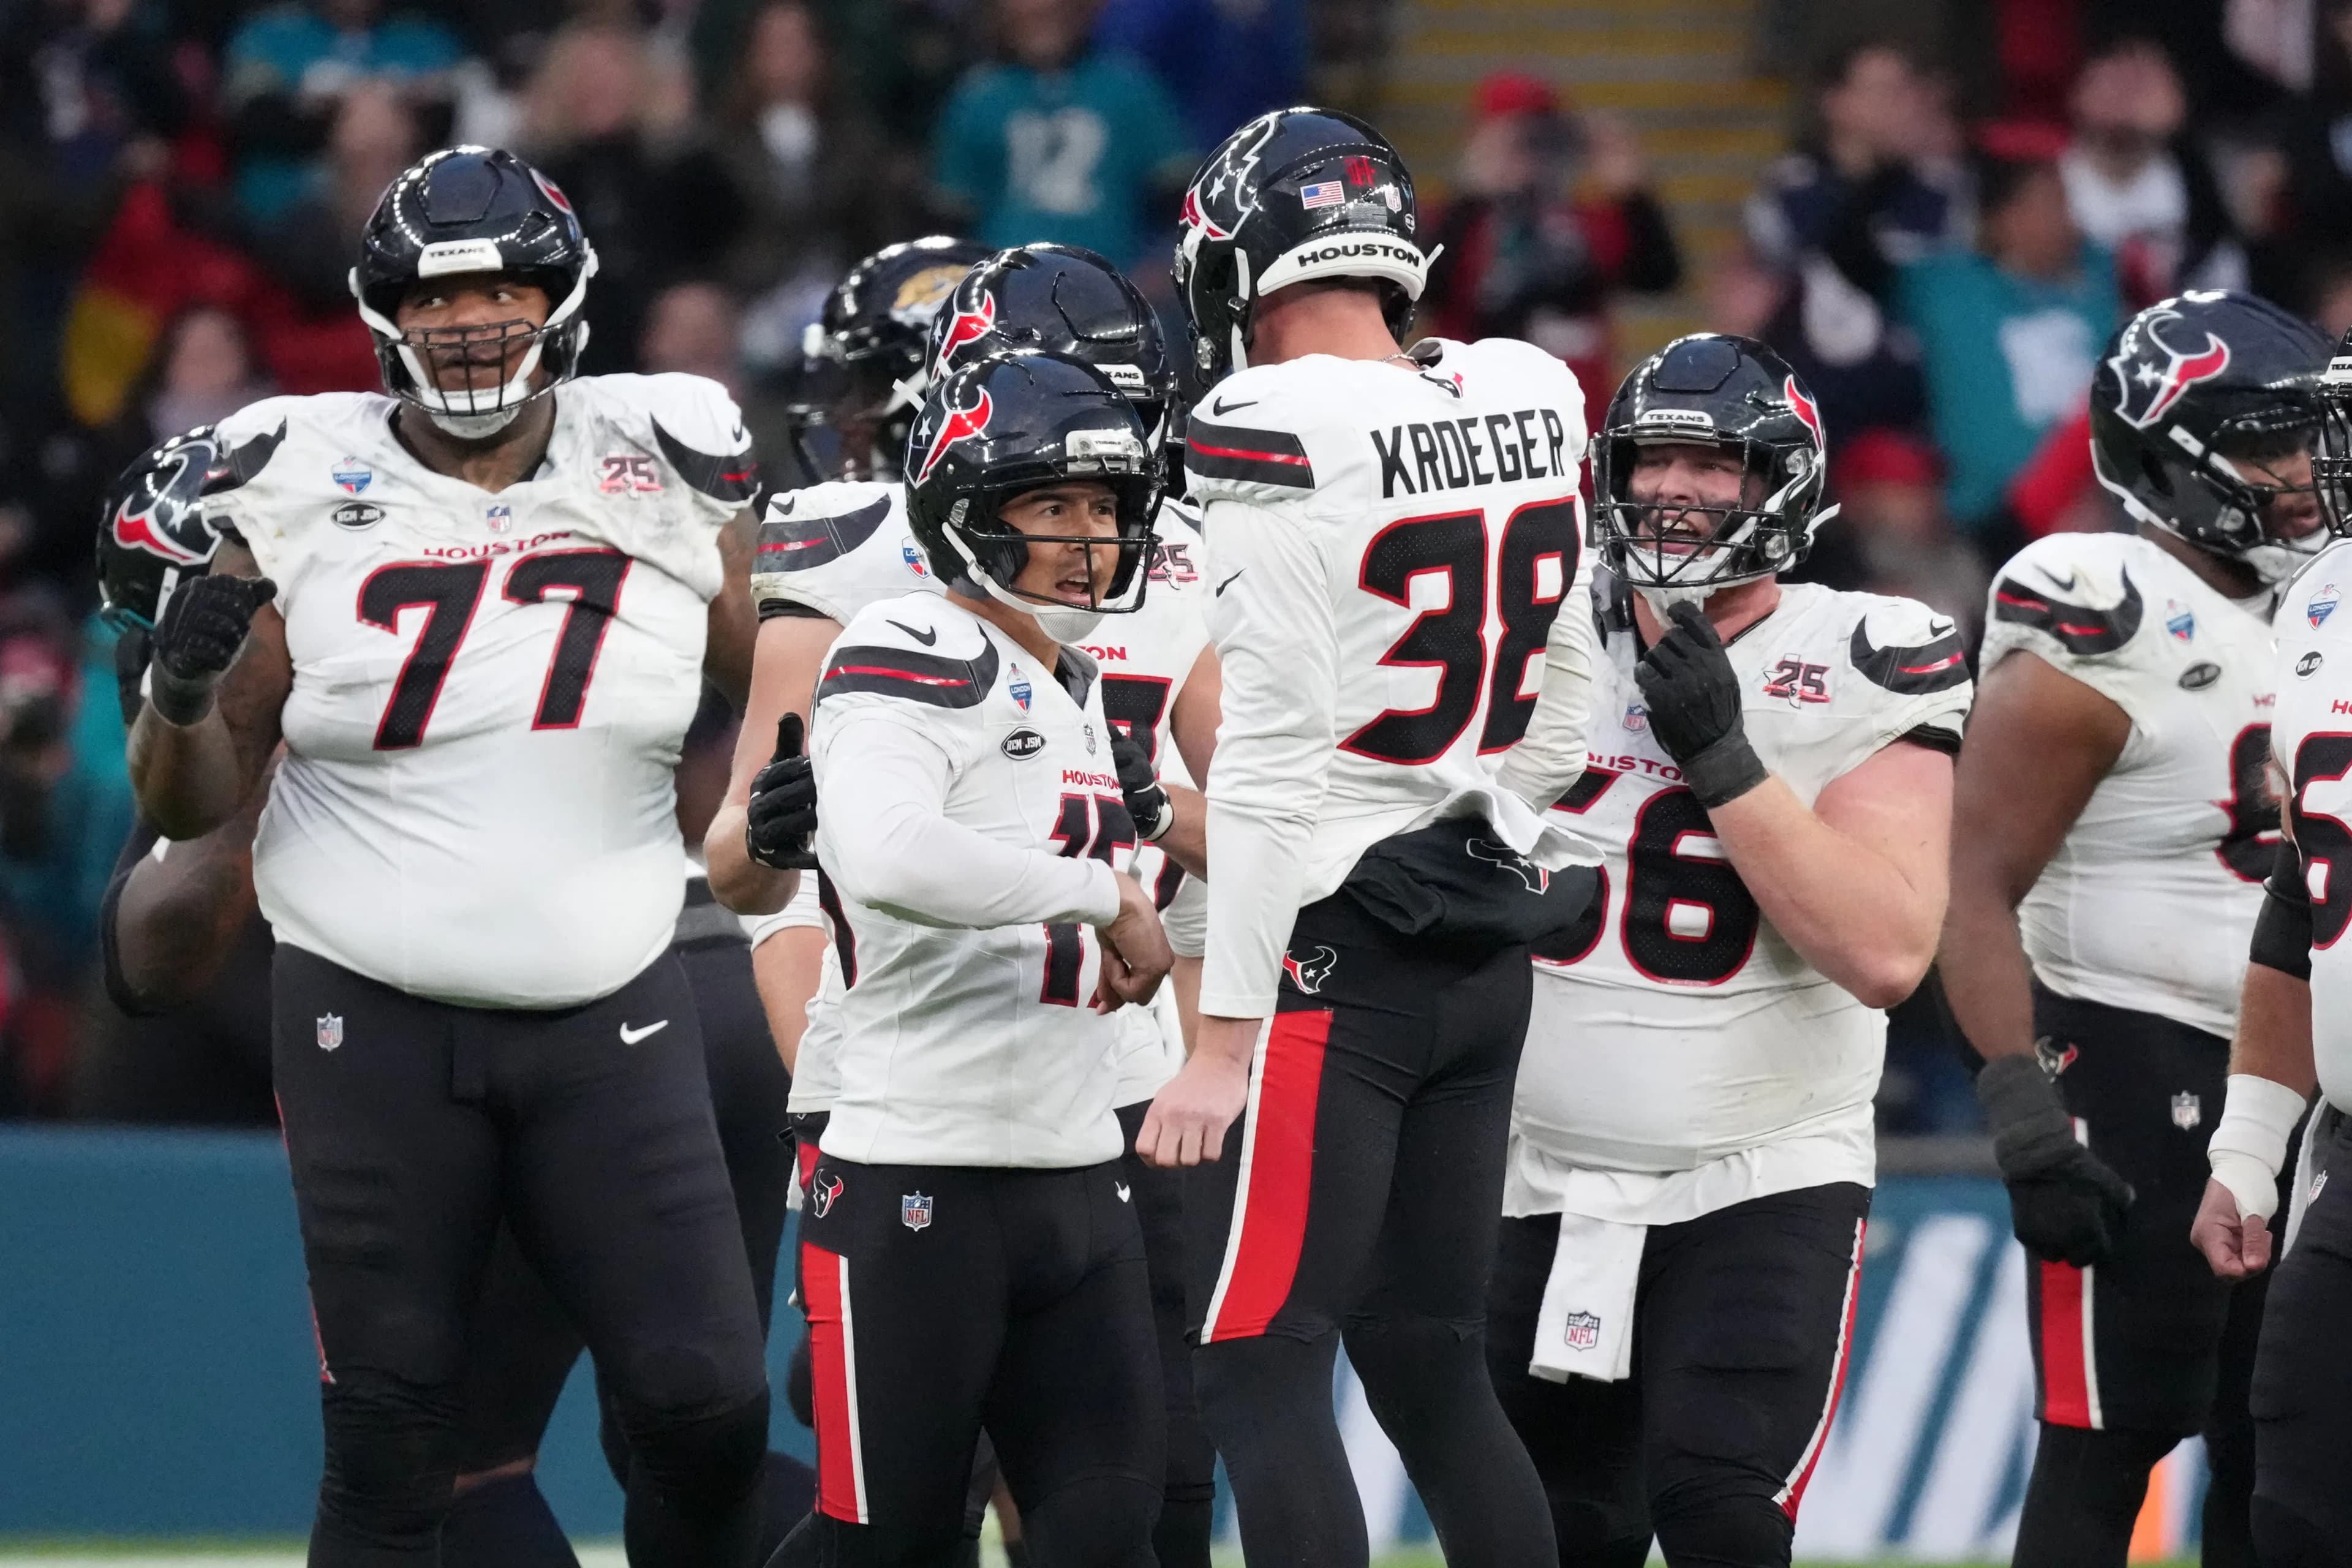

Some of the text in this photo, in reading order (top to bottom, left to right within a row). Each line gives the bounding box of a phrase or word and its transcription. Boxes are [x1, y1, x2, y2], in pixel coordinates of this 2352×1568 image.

[1298, 244, 1419, 267] HOUSTON
[1370, 409, 1565, 499] KROEGER
[603, 457, 654, 483] 25
[424, 532, 571, 559] HOUSTON
[1336, 495, 1581, 766] 38
[356, 547, 633, 751] 77
[1772, 660, 1831, 695] 25
[1006, 736, 1041, 751] RCM JSM
[1063, 770, 1121, 790] HOUSTON
[908, 1209, 927, 1224] NFL
[1568, 1327, 1593, 1344] NFL
